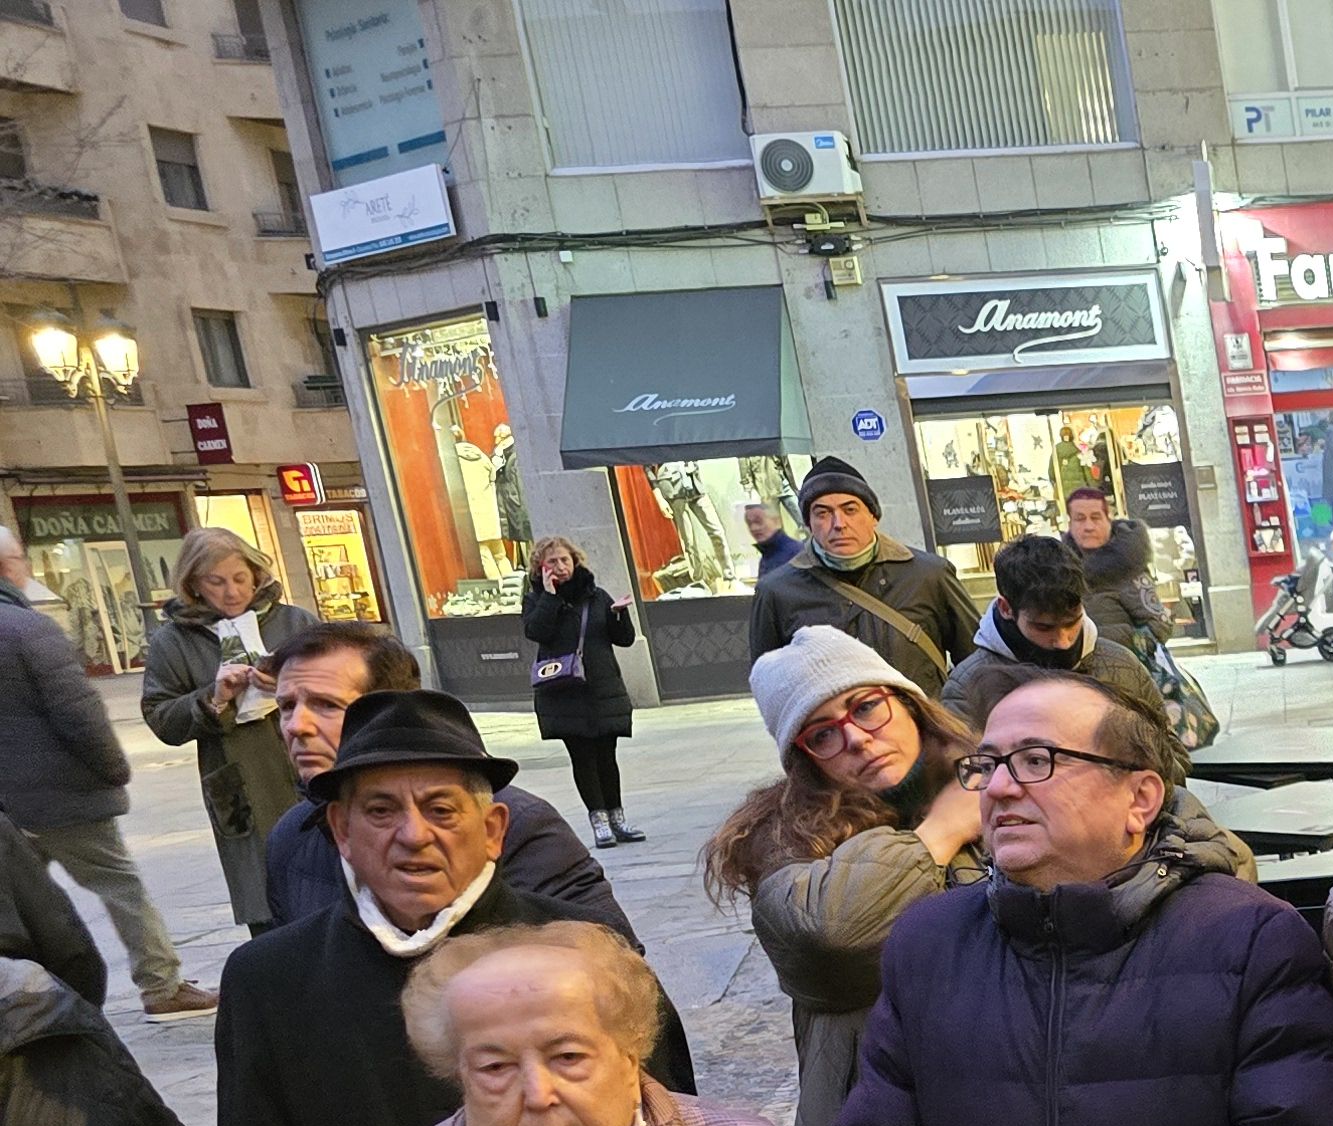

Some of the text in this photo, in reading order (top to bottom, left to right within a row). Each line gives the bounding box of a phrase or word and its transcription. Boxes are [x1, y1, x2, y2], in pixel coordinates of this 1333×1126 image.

[1305, 107, 1332, 118] PILAR
[958, 299, 1101, 364] Anamont
[611, 393, 737, 426] Anamont
[857, 417, 878, 431] ADT
[31, 511, 170, 537] DOÑA CAMEN
